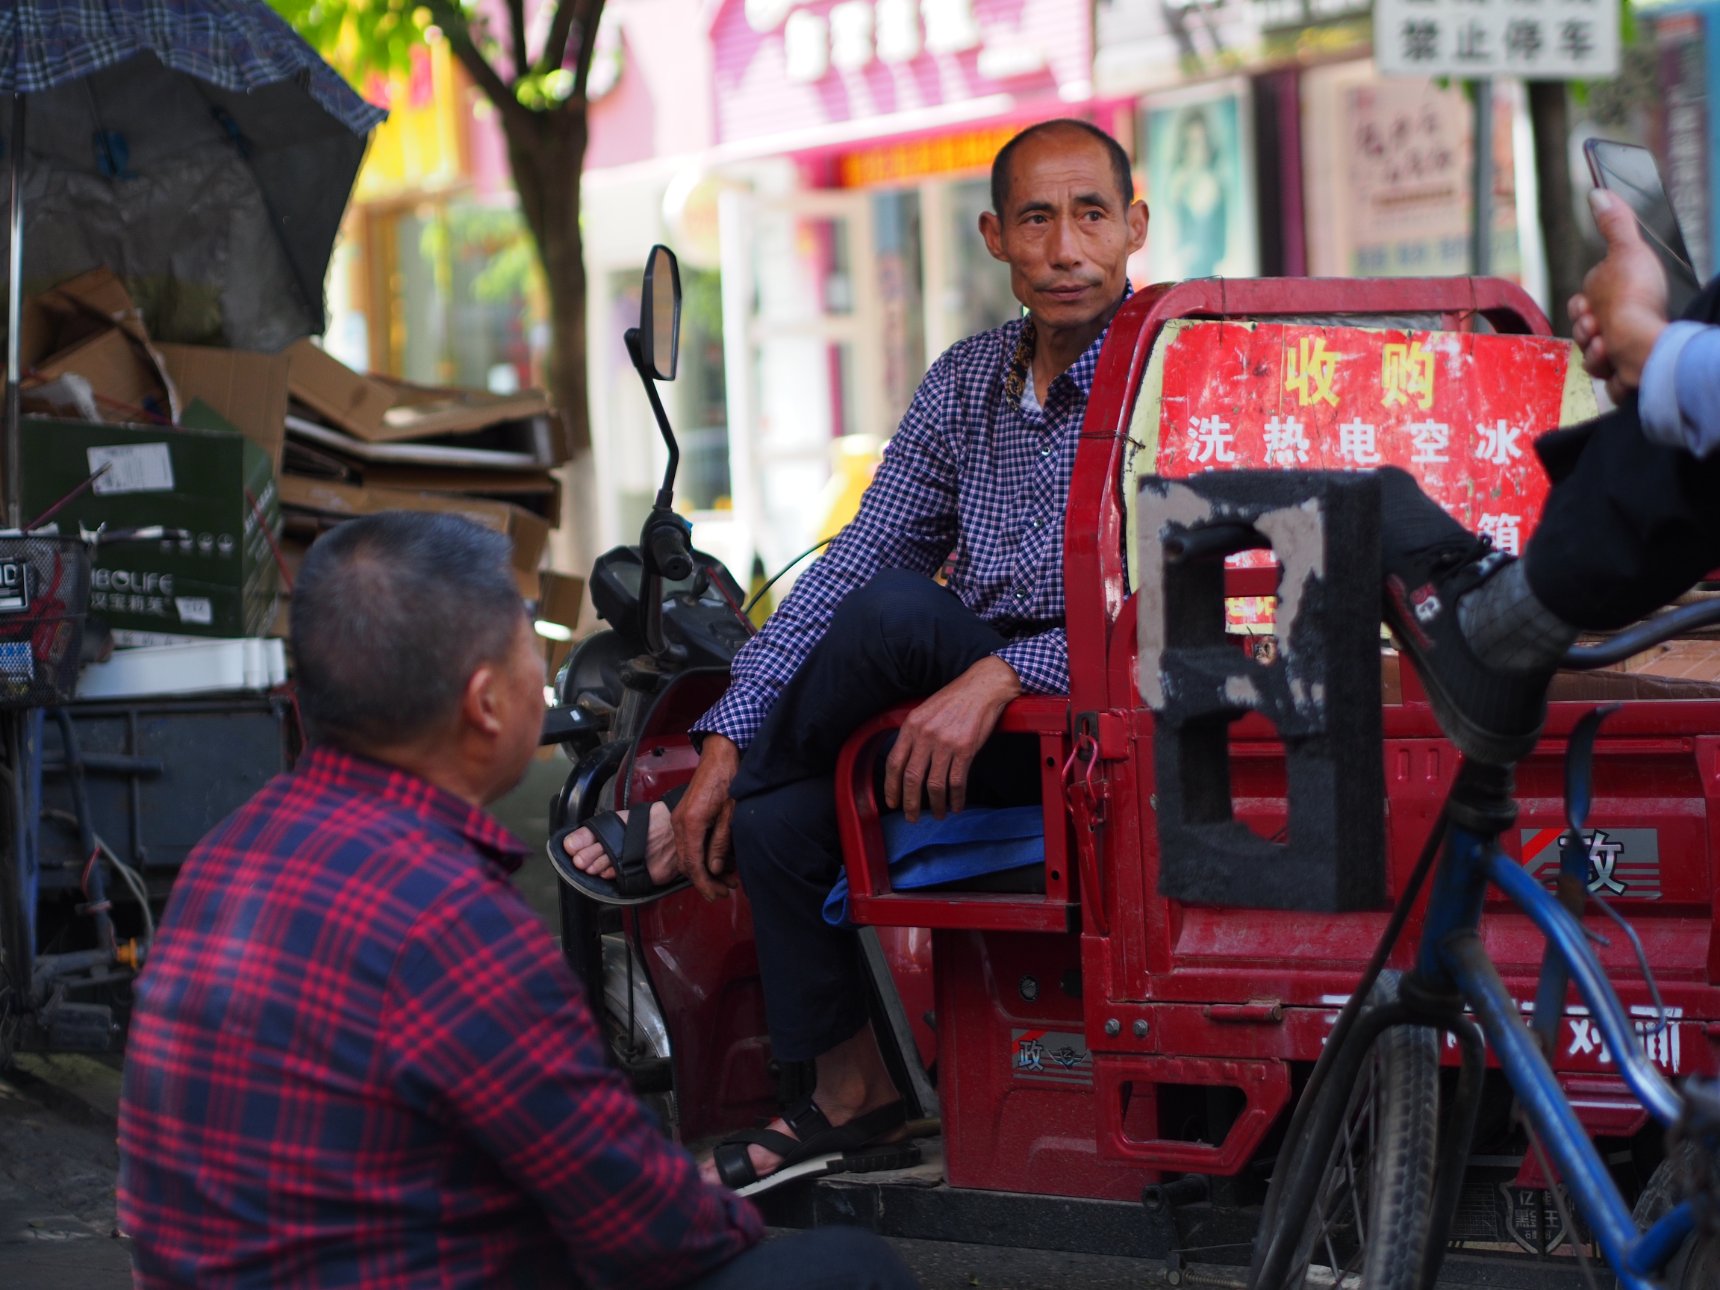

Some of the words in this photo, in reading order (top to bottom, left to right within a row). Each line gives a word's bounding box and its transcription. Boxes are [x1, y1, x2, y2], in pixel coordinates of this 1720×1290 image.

[1401, 18, 1595, 62] 禁止停车
[1286, 337, 1436, 409] 收购
[1019, 1040, 1044, 1071] 政
